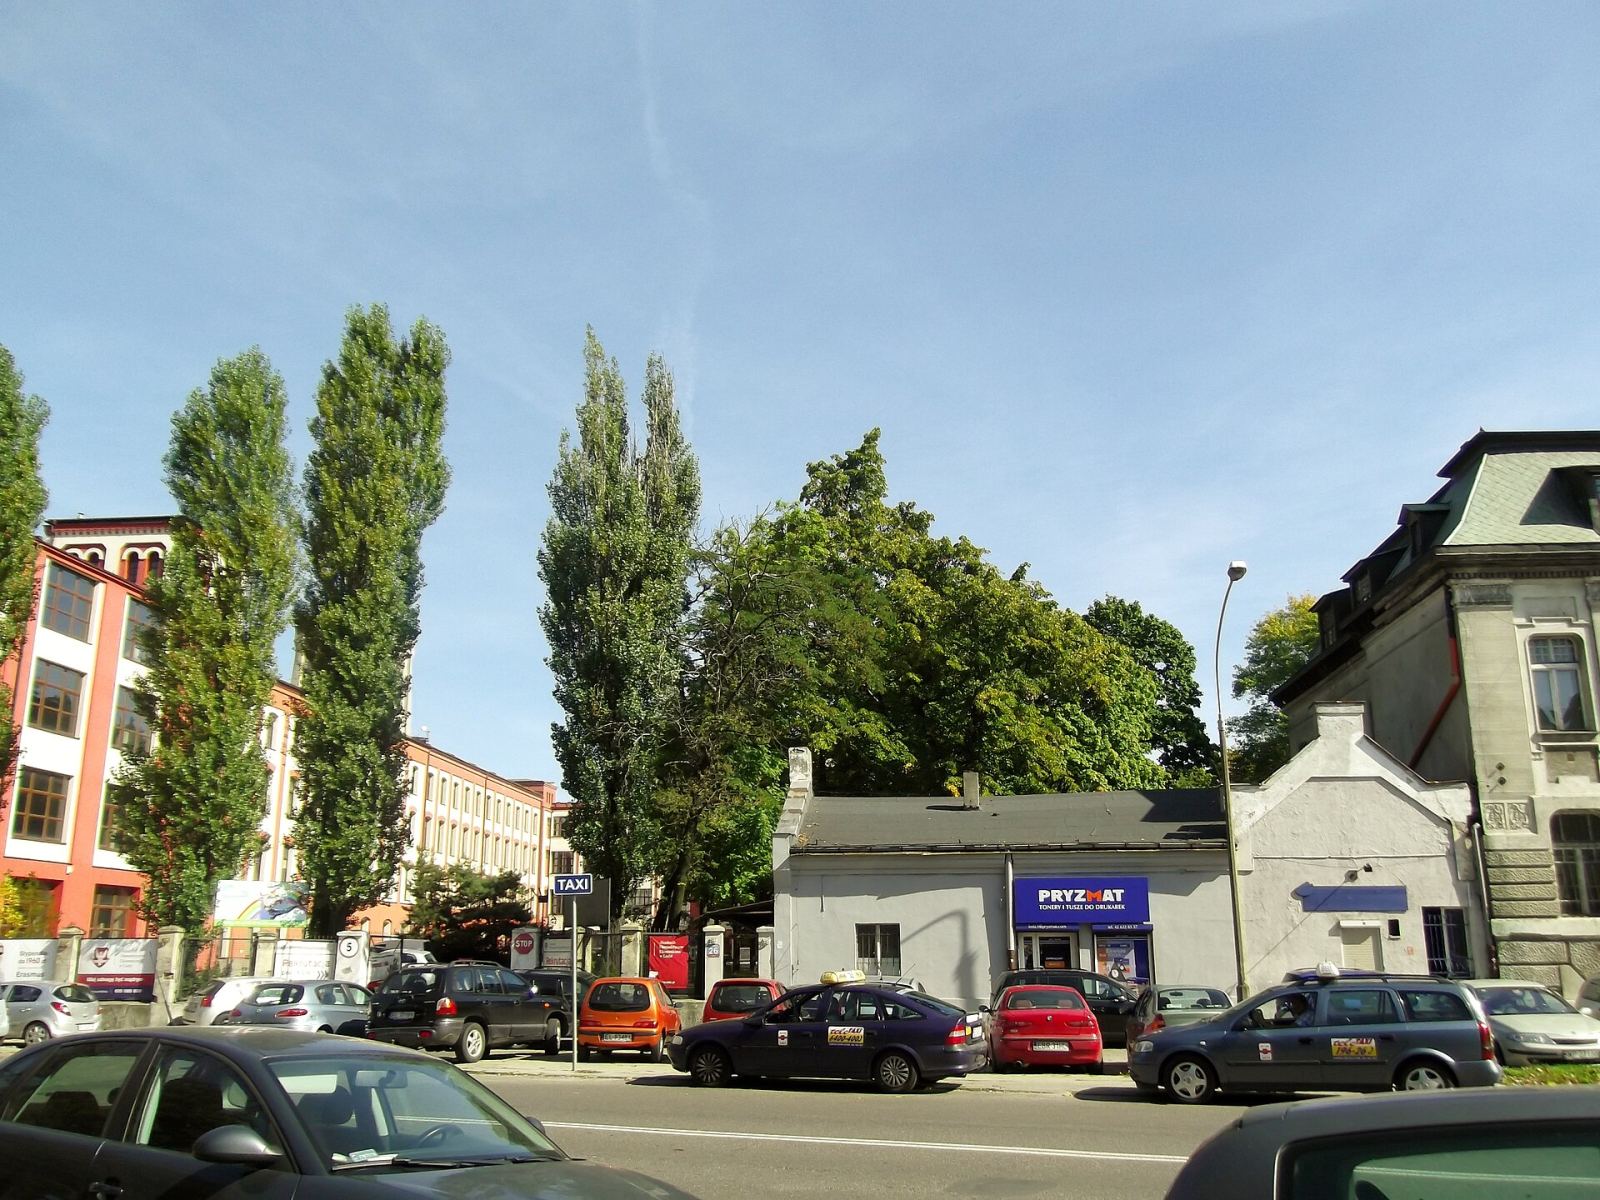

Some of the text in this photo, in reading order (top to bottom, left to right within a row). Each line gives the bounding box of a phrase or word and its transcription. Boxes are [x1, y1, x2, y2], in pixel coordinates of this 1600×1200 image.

[557, 878, 589, 891] TAXI
[1038, 889, 1125, 903] PRYZMAT
[346, 942, 352, 952] 5
[515, 940, 533, 948] STOP
[708, 947, 719, 955] 26
